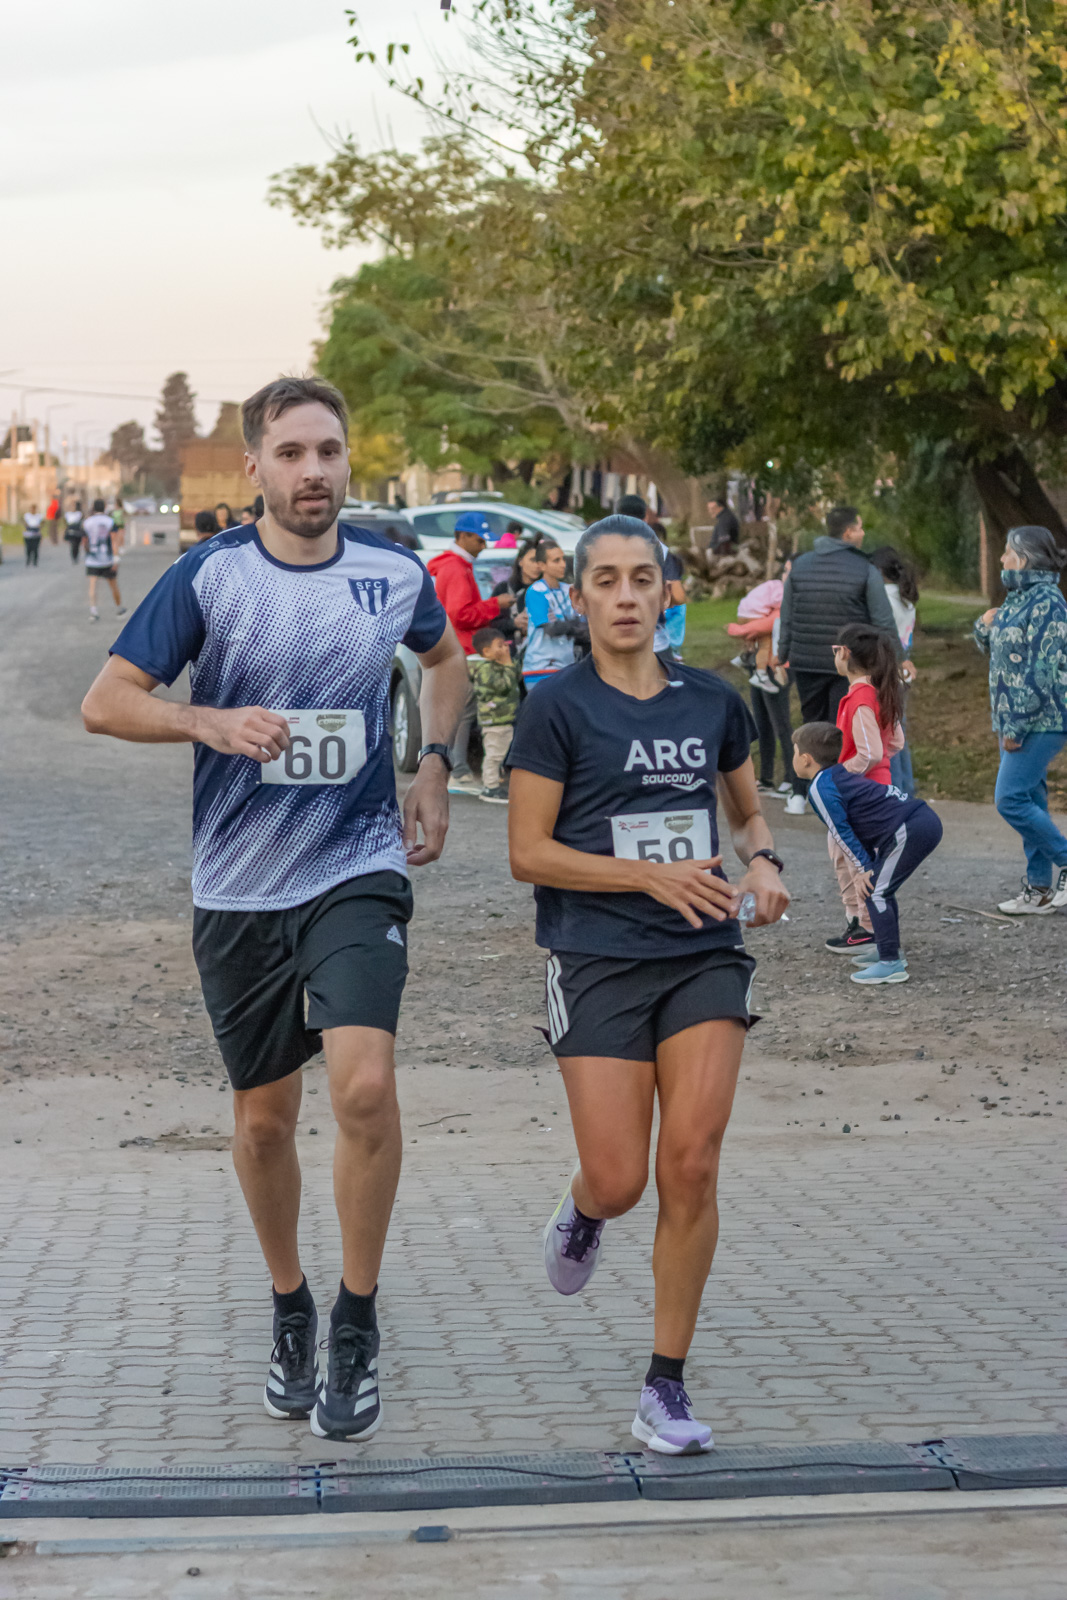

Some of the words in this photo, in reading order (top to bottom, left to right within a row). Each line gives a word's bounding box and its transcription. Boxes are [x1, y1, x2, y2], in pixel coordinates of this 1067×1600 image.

[355, 581, 382, 590] SFC
[284, 735, 346, 780] 60
[624, 737, 707, 772] ARG
[641, 773, 695, 785] saucony
